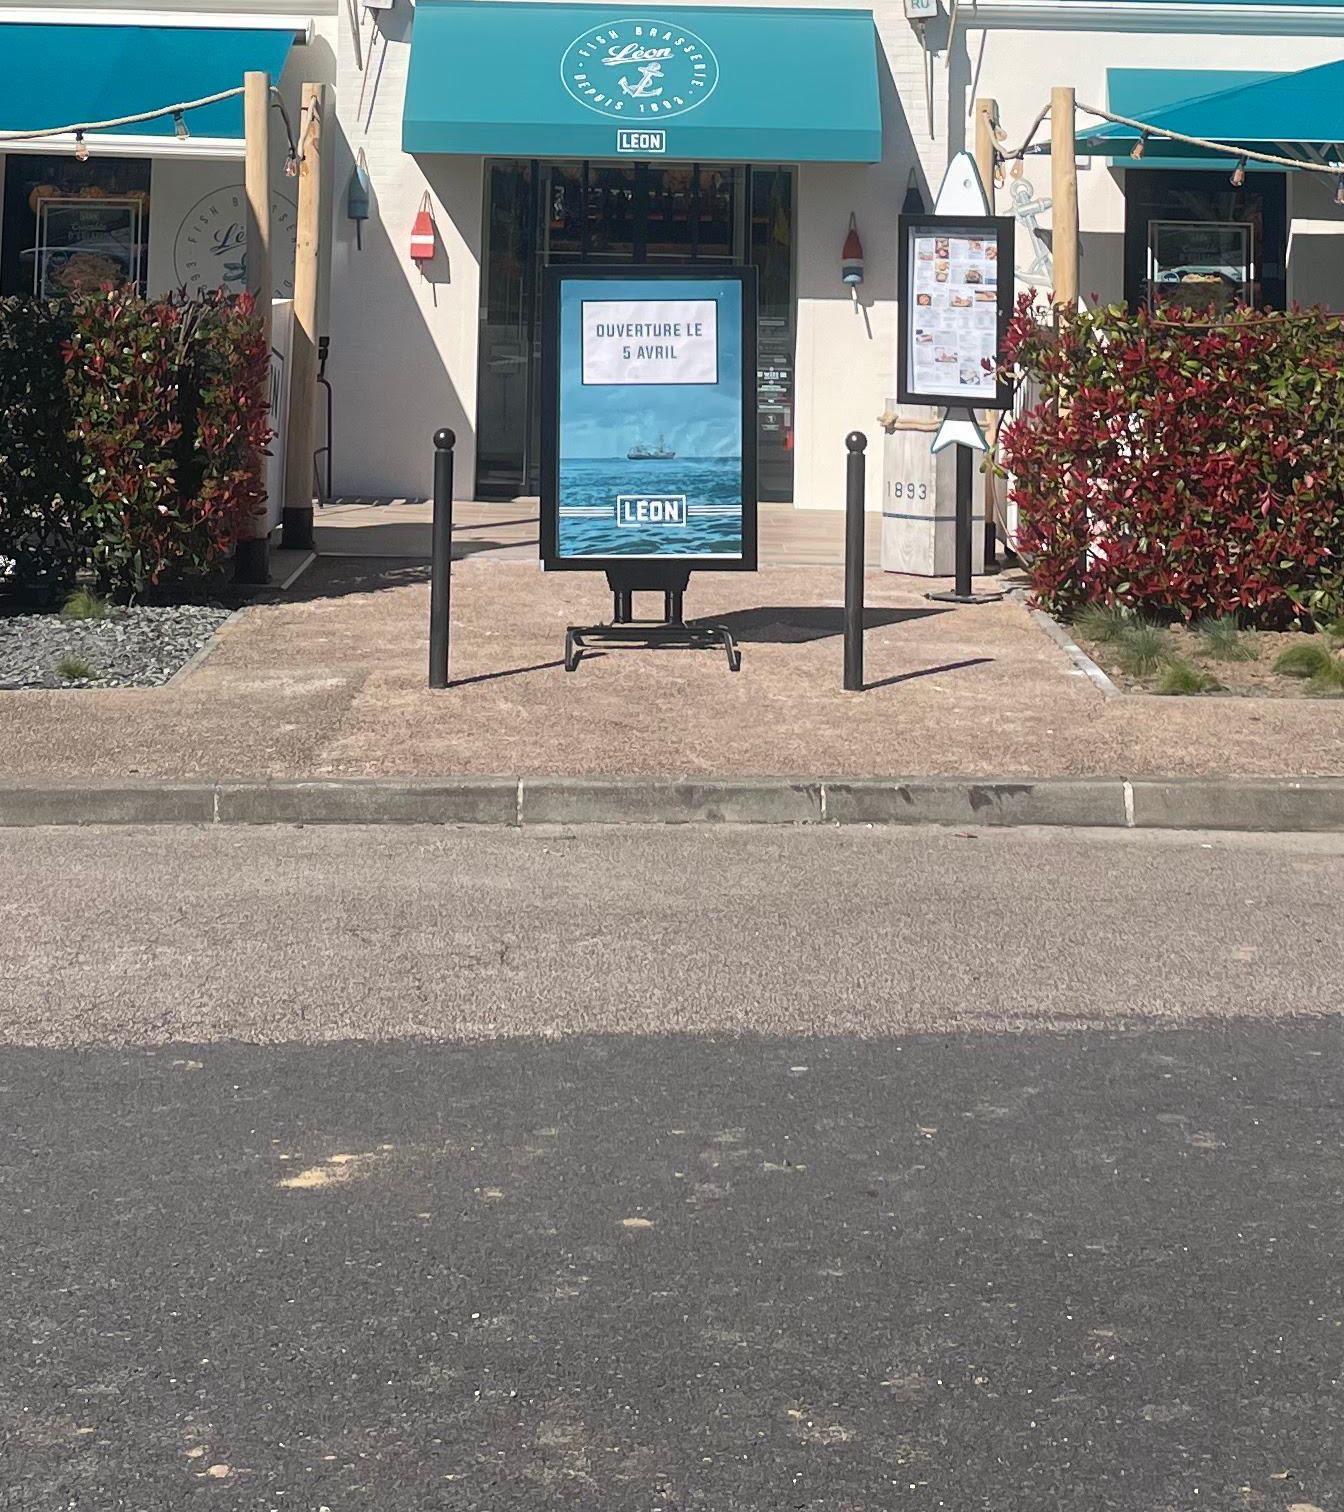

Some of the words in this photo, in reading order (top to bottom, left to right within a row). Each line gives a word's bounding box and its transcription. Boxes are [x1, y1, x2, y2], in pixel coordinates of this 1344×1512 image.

[578, 29, 619, 57] FISH
[635, 26, 706, 87] BRASSERIE
[574, 74, 624, 112] DEPUIS
[187, 206, 219, 244] FISH
[596, 323, 681, 337] OUVERTURE
[687, 322, 703, 336] LE
[623, 346, 631, 359] 5
[637, 345, 677, 359] AVRIL
[887, 480, 927, 500] 1893
